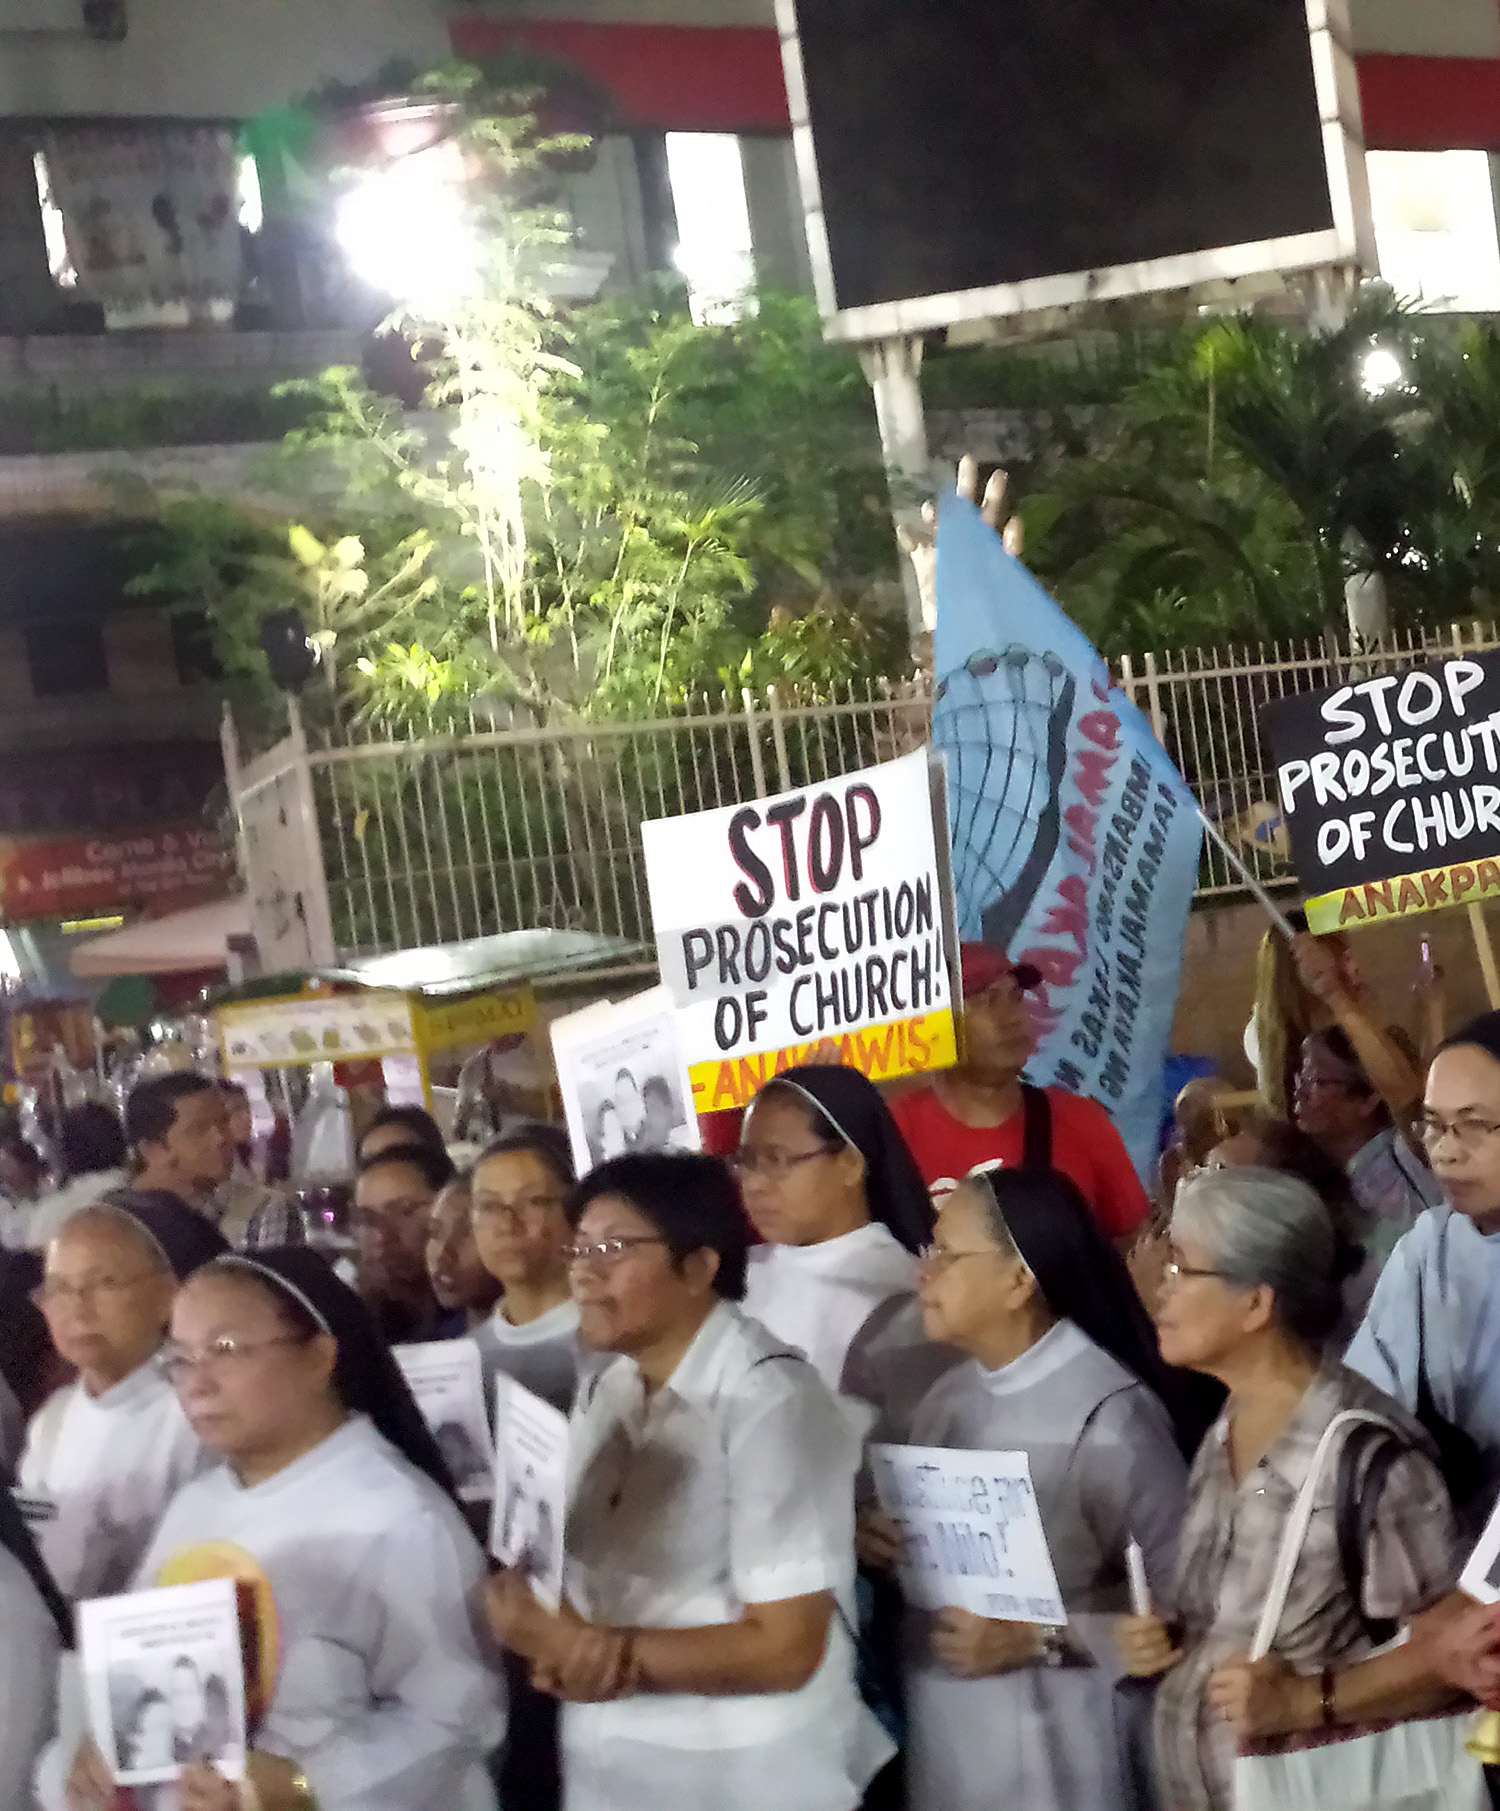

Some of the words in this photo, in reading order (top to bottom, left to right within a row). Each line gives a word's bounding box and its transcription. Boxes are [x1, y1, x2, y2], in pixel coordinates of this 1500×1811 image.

[1320, 659, 1486, 746] STOP
[728, 781, 882, 919] STOP
[1317, 810, 1376, 866] OF
[682, 871, 934, 991] PROSECUTION
[714, 990, 768, 1051] OF
[789, 926, 942, 1037] CHURCH!
